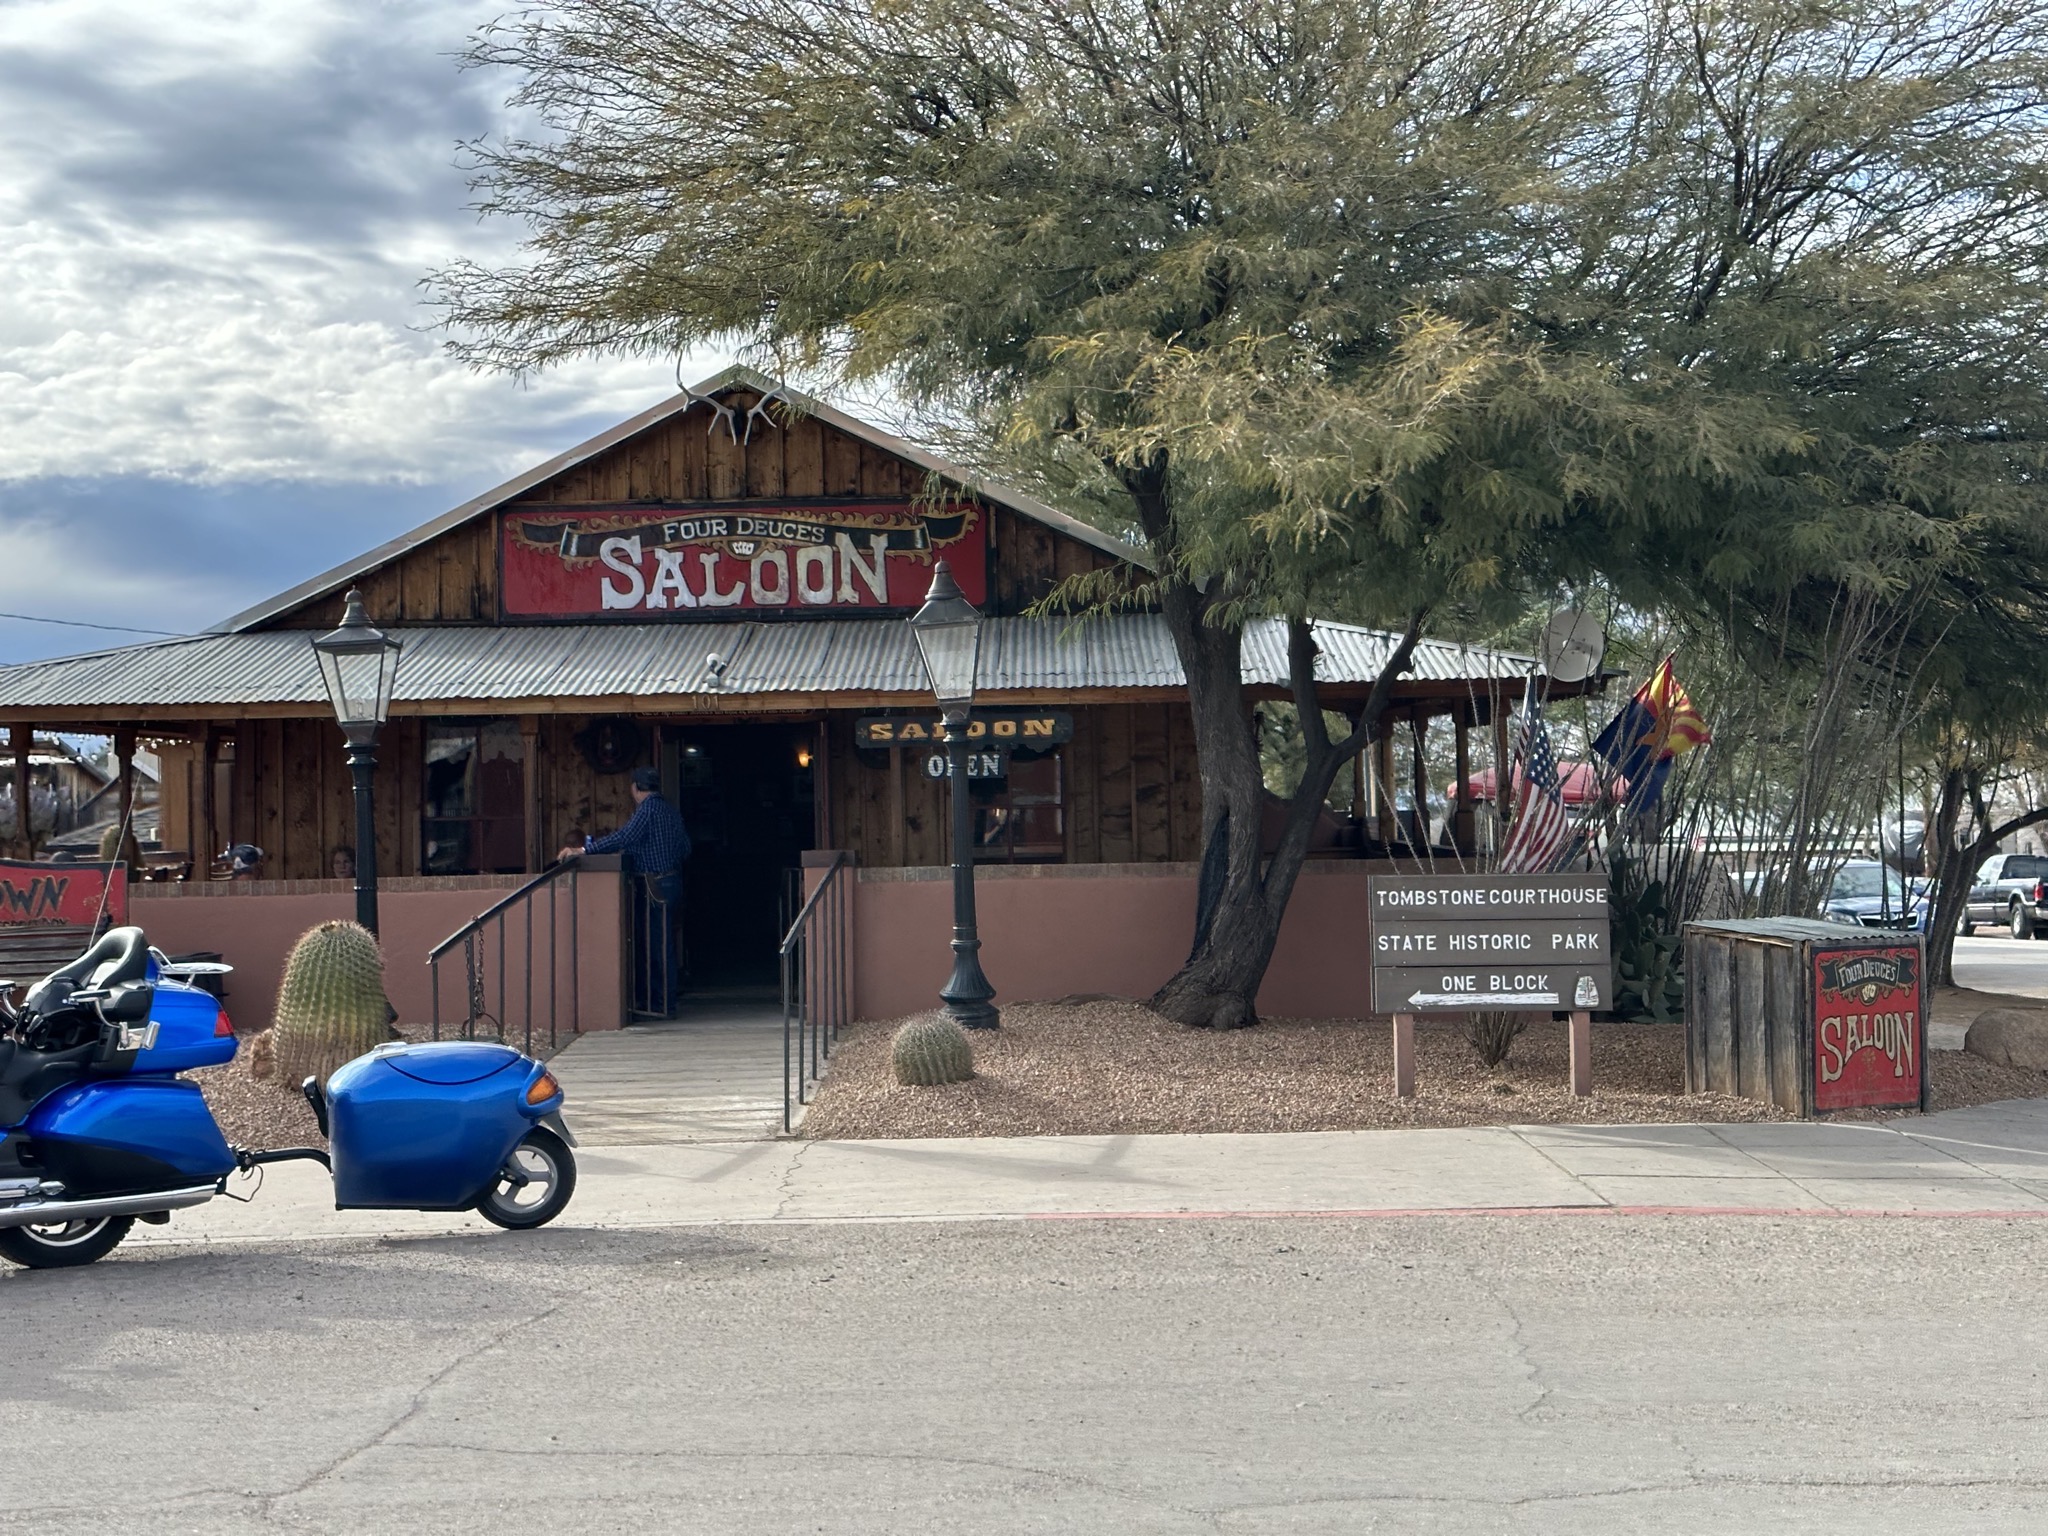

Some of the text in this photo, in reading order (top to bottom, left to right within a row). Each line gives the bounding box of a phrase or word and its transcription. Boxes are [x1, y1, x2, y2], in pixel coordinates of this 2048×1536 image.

[663, 517, 826, 542] FOUR DEUCES
[599, 532, 889, 610] SALOON
[691, 695, 720, 710] 101
[927, 754, 1000, 777] OEN
[1377, 888, 1607, 906] TOMBSTONE COURTHOUSE
[1378, 933, 1599, 951] STATE HISTORIC PARK
[1442, 975, 1549, 991] ONE BLOCK
[1839, 959, 1896, 987] FOUR DEUCES
[1820, 1011, 1914, 1083] SALOON
